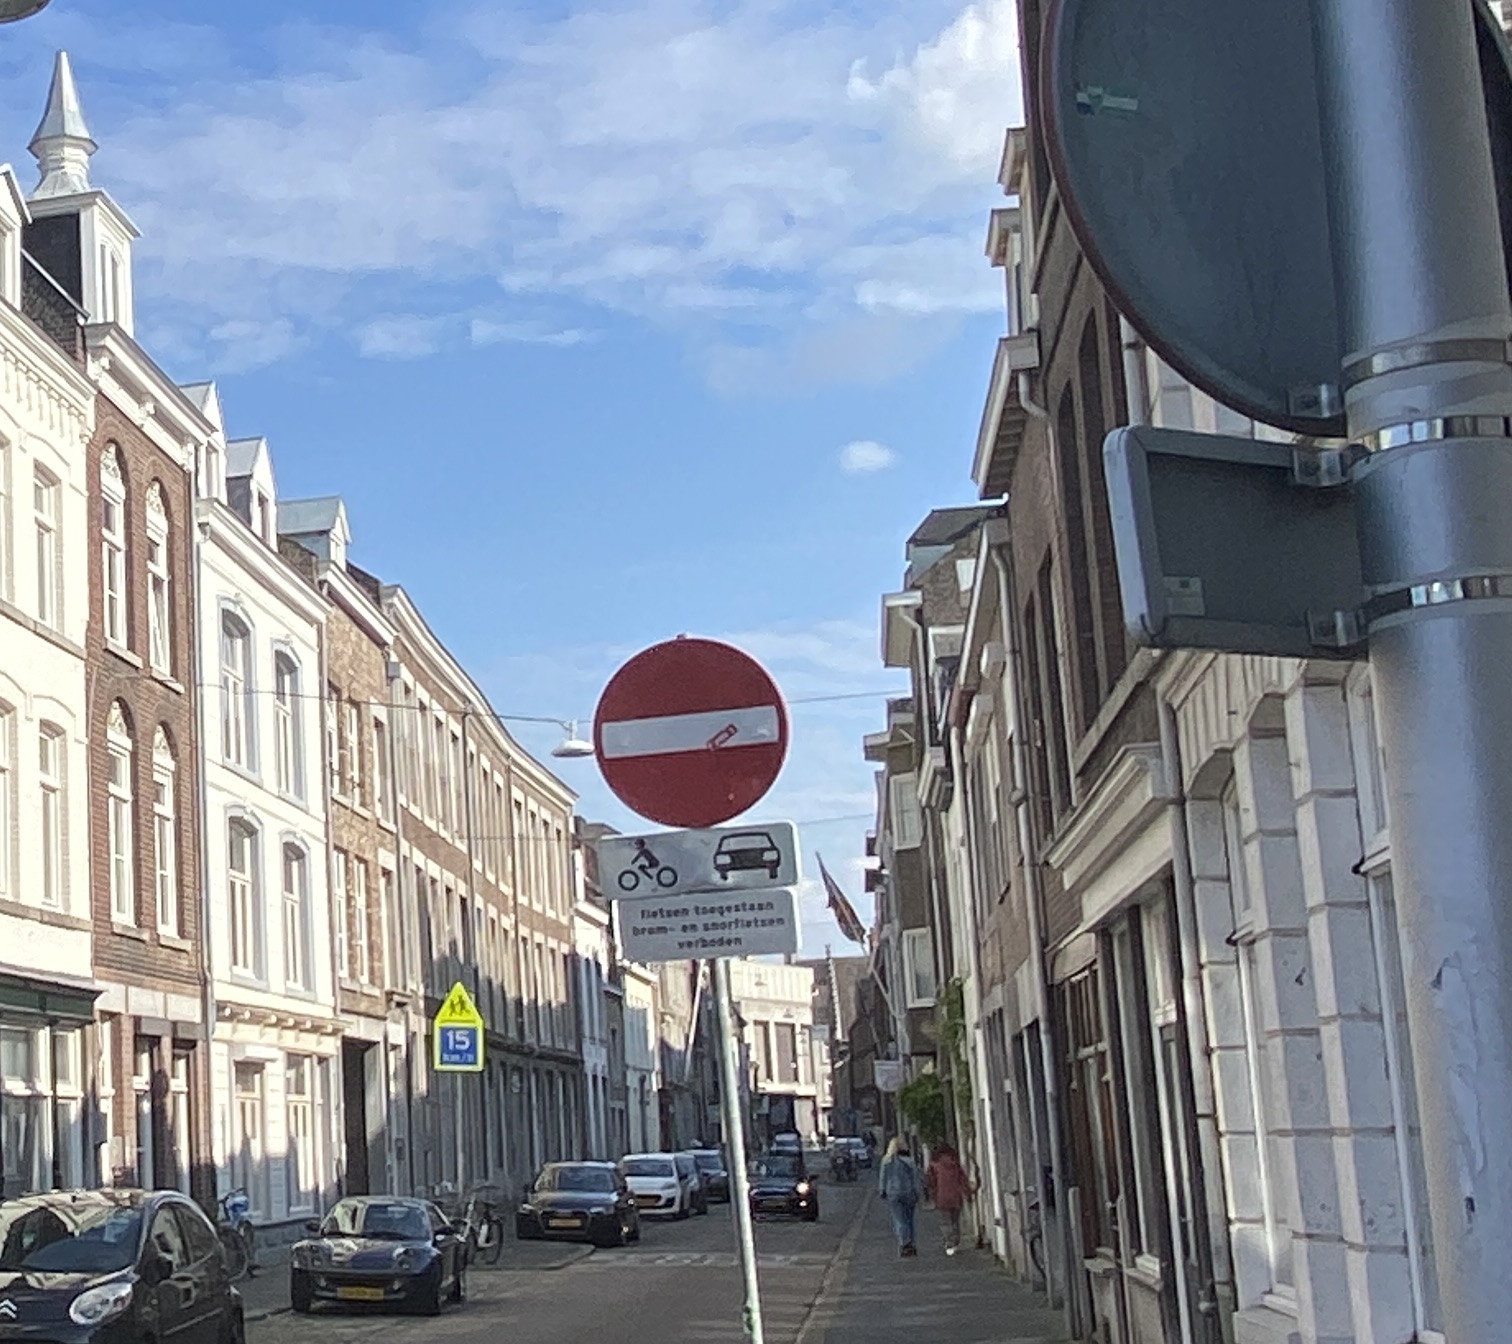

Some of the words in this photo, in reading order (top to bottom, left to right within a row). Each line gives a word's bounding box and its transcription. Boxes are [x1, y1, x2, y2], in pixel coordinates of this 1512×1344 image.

[694, 901, 774, 917] toegestaan
[681, 924, 698, 933] en
[703, 917, 785, 932] snorfietsen
[678, 937, 742, 949] verboden
[446, 1029, 470, 1051] 15
